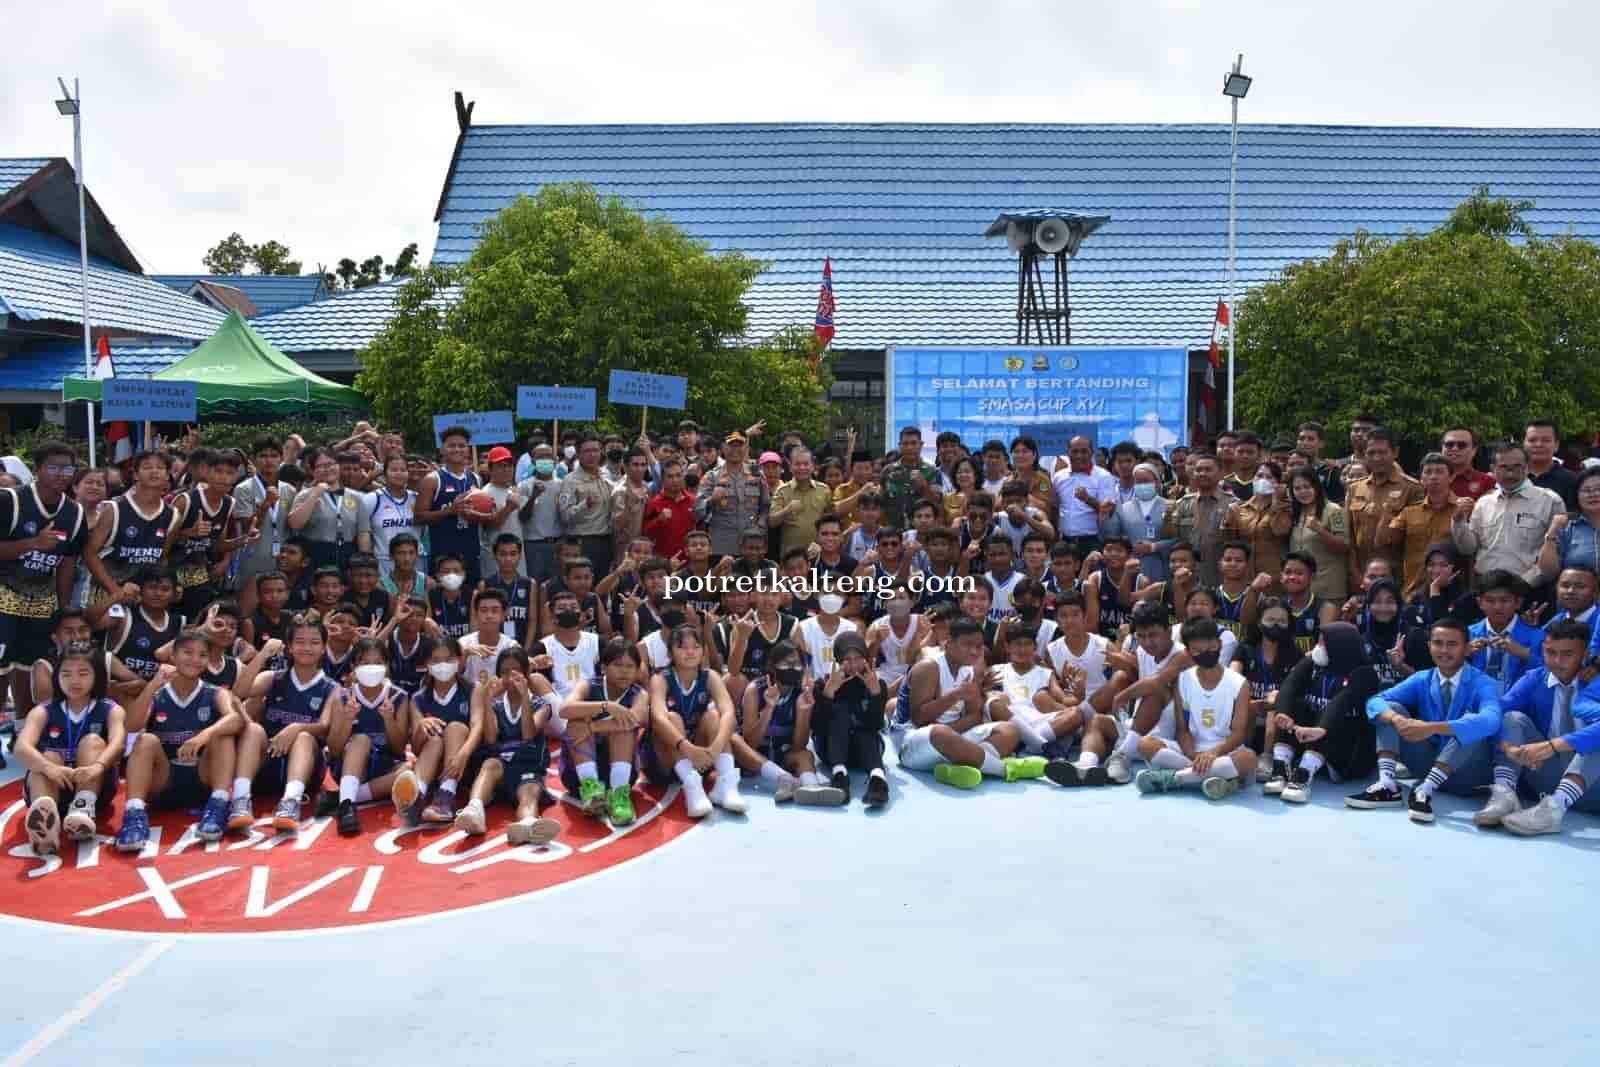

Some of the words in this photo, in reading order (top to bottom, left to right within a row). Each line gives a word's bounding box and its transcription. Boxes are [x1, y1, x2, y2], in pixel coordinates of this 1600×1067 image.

[931, 378, 1020, 390] SELAMAT
[1025, 377, 1150, 389] BERTANDING
[1076, 398, 1106, 411] XVI
[1199, 708, 1217, 729] 5
[72, 865, 384, 919] XVI
